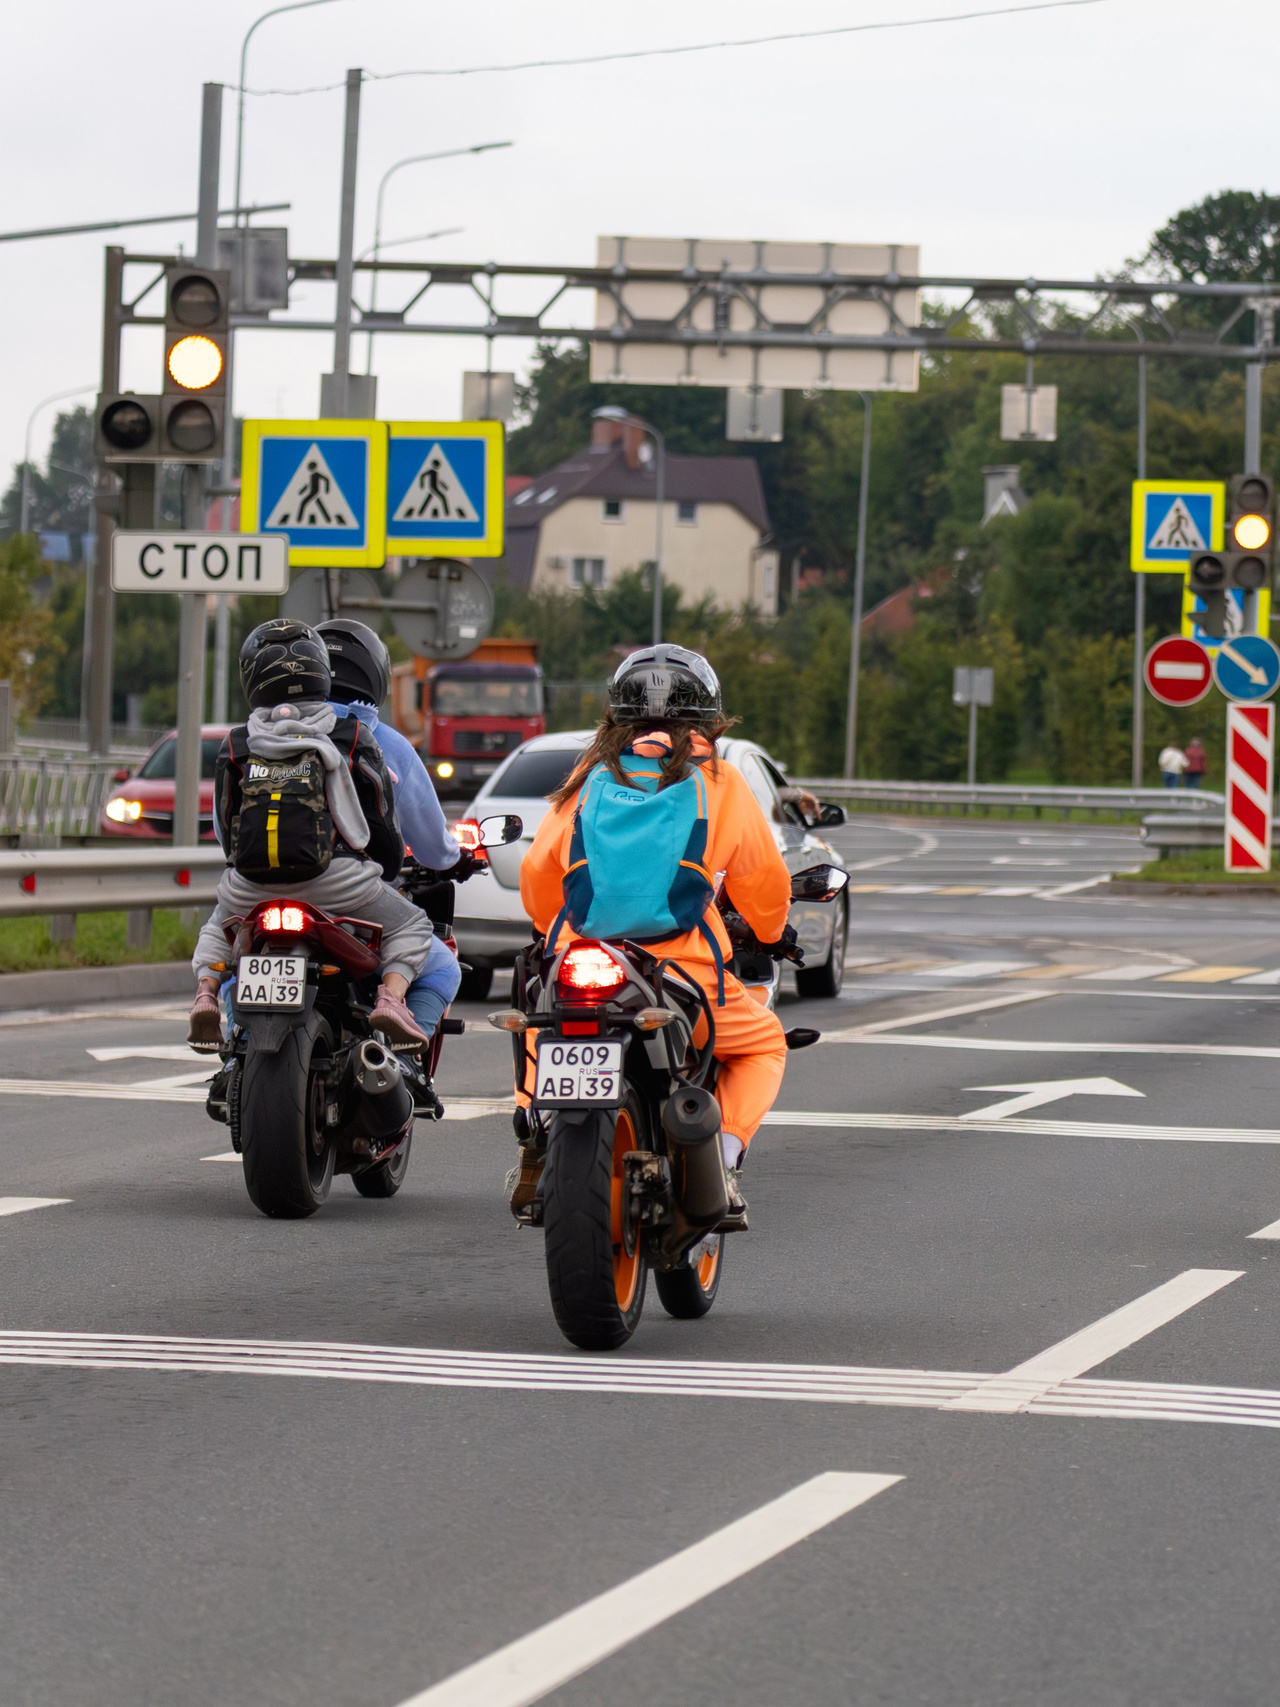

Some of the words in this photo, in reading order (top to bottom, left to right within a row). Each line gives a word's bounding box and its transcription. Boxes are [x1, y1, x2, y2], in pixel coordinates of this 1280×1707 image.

[139, 543, 261, 580] СТОП
[249, 764, 269, 778] NO
[248, 958, 296, 976] 8015
[240, 984, 267, 1001] AA
[275, 985, 299, 1002] 39
[551, 1046, 609, 1066] 0609
[541, 1077, 575, 1097] AB
[585, 1077, 614, 1097] 39
